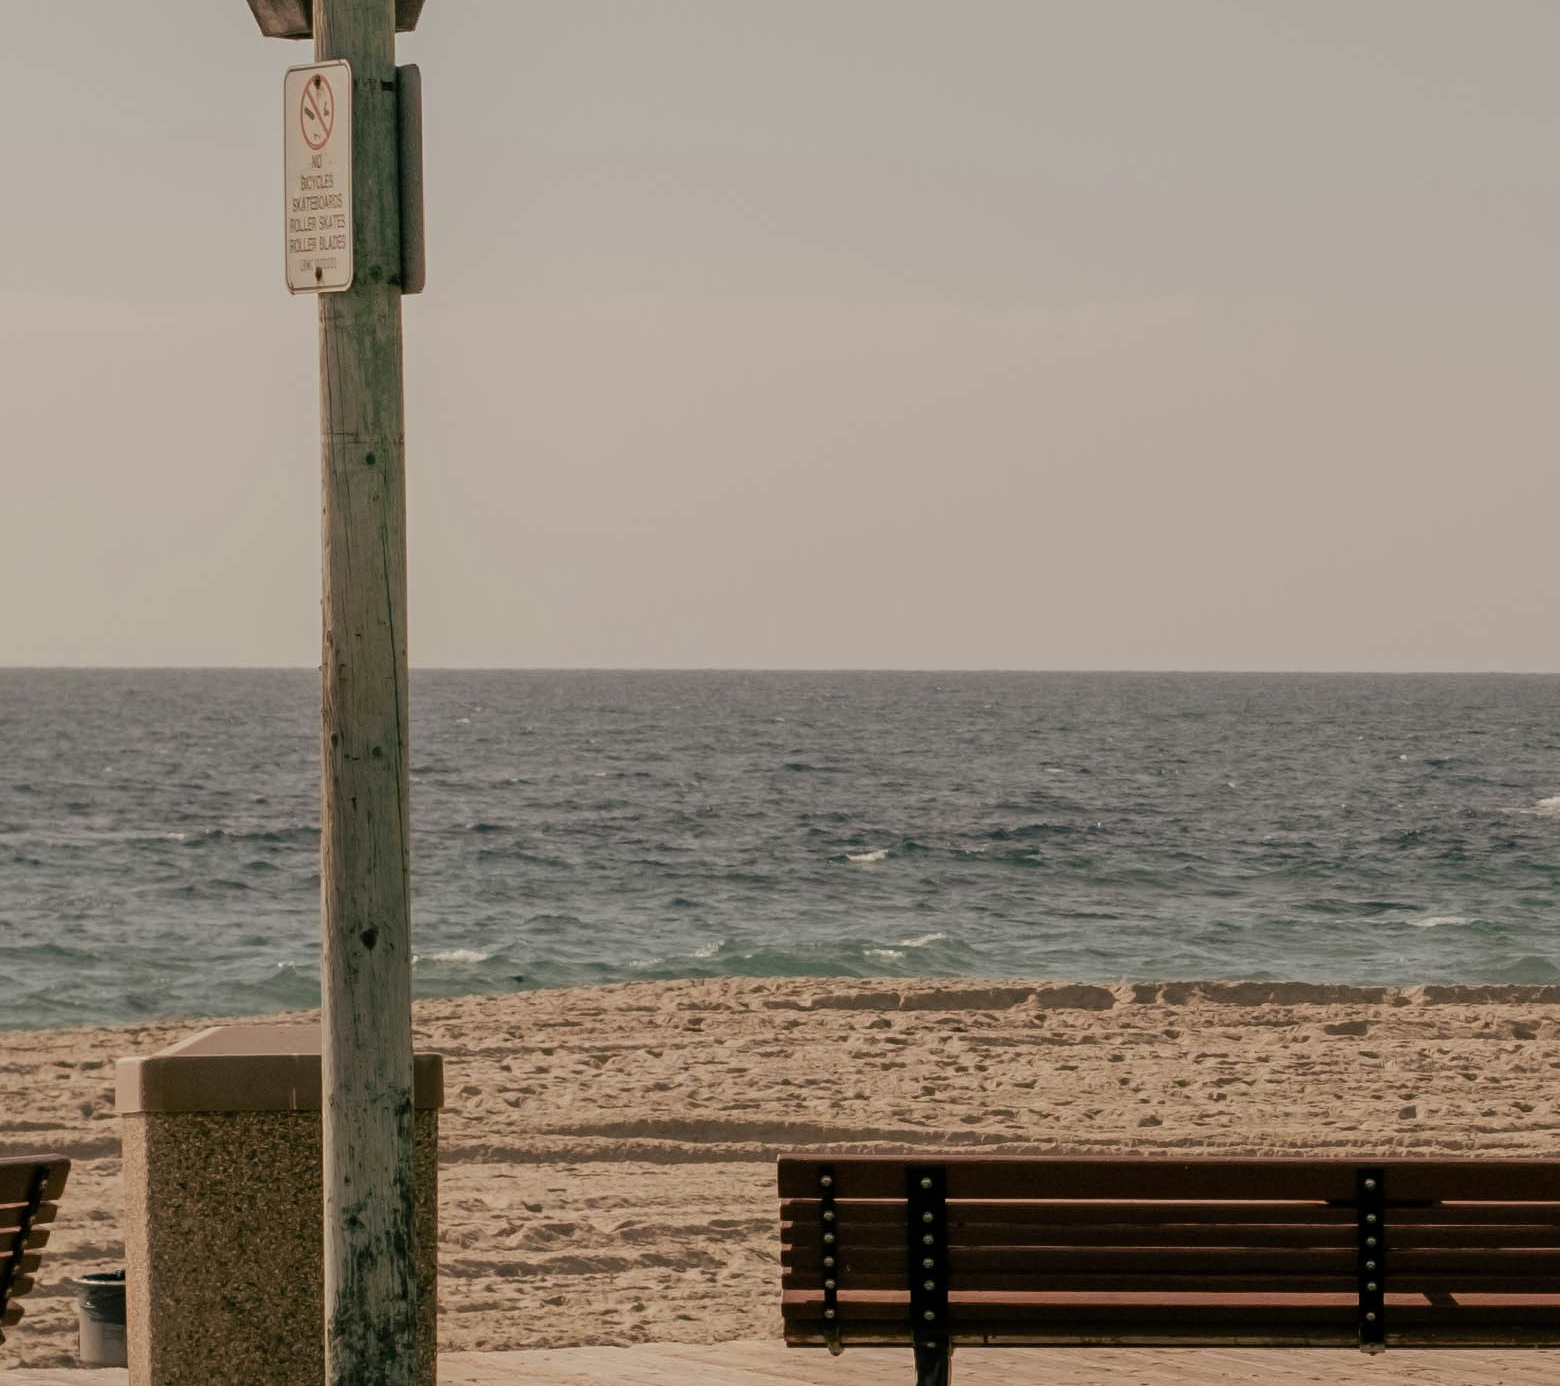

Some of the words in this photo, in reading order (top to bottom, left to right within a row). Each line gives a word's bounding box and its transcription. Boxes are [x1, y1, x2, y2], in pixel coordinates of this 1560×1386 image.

[311, 154, 322, 169] NO
[300, 173, 334, 191] BICYCLES
[292, 193, 343, 212] SKATEBOARDS
[289, 216, 316, 232] ROLLER
[319, 214, 345, 230] SKATES
[289, 236, 316, 253] ROLLER
[319, 234, 345, 251] BLADES
